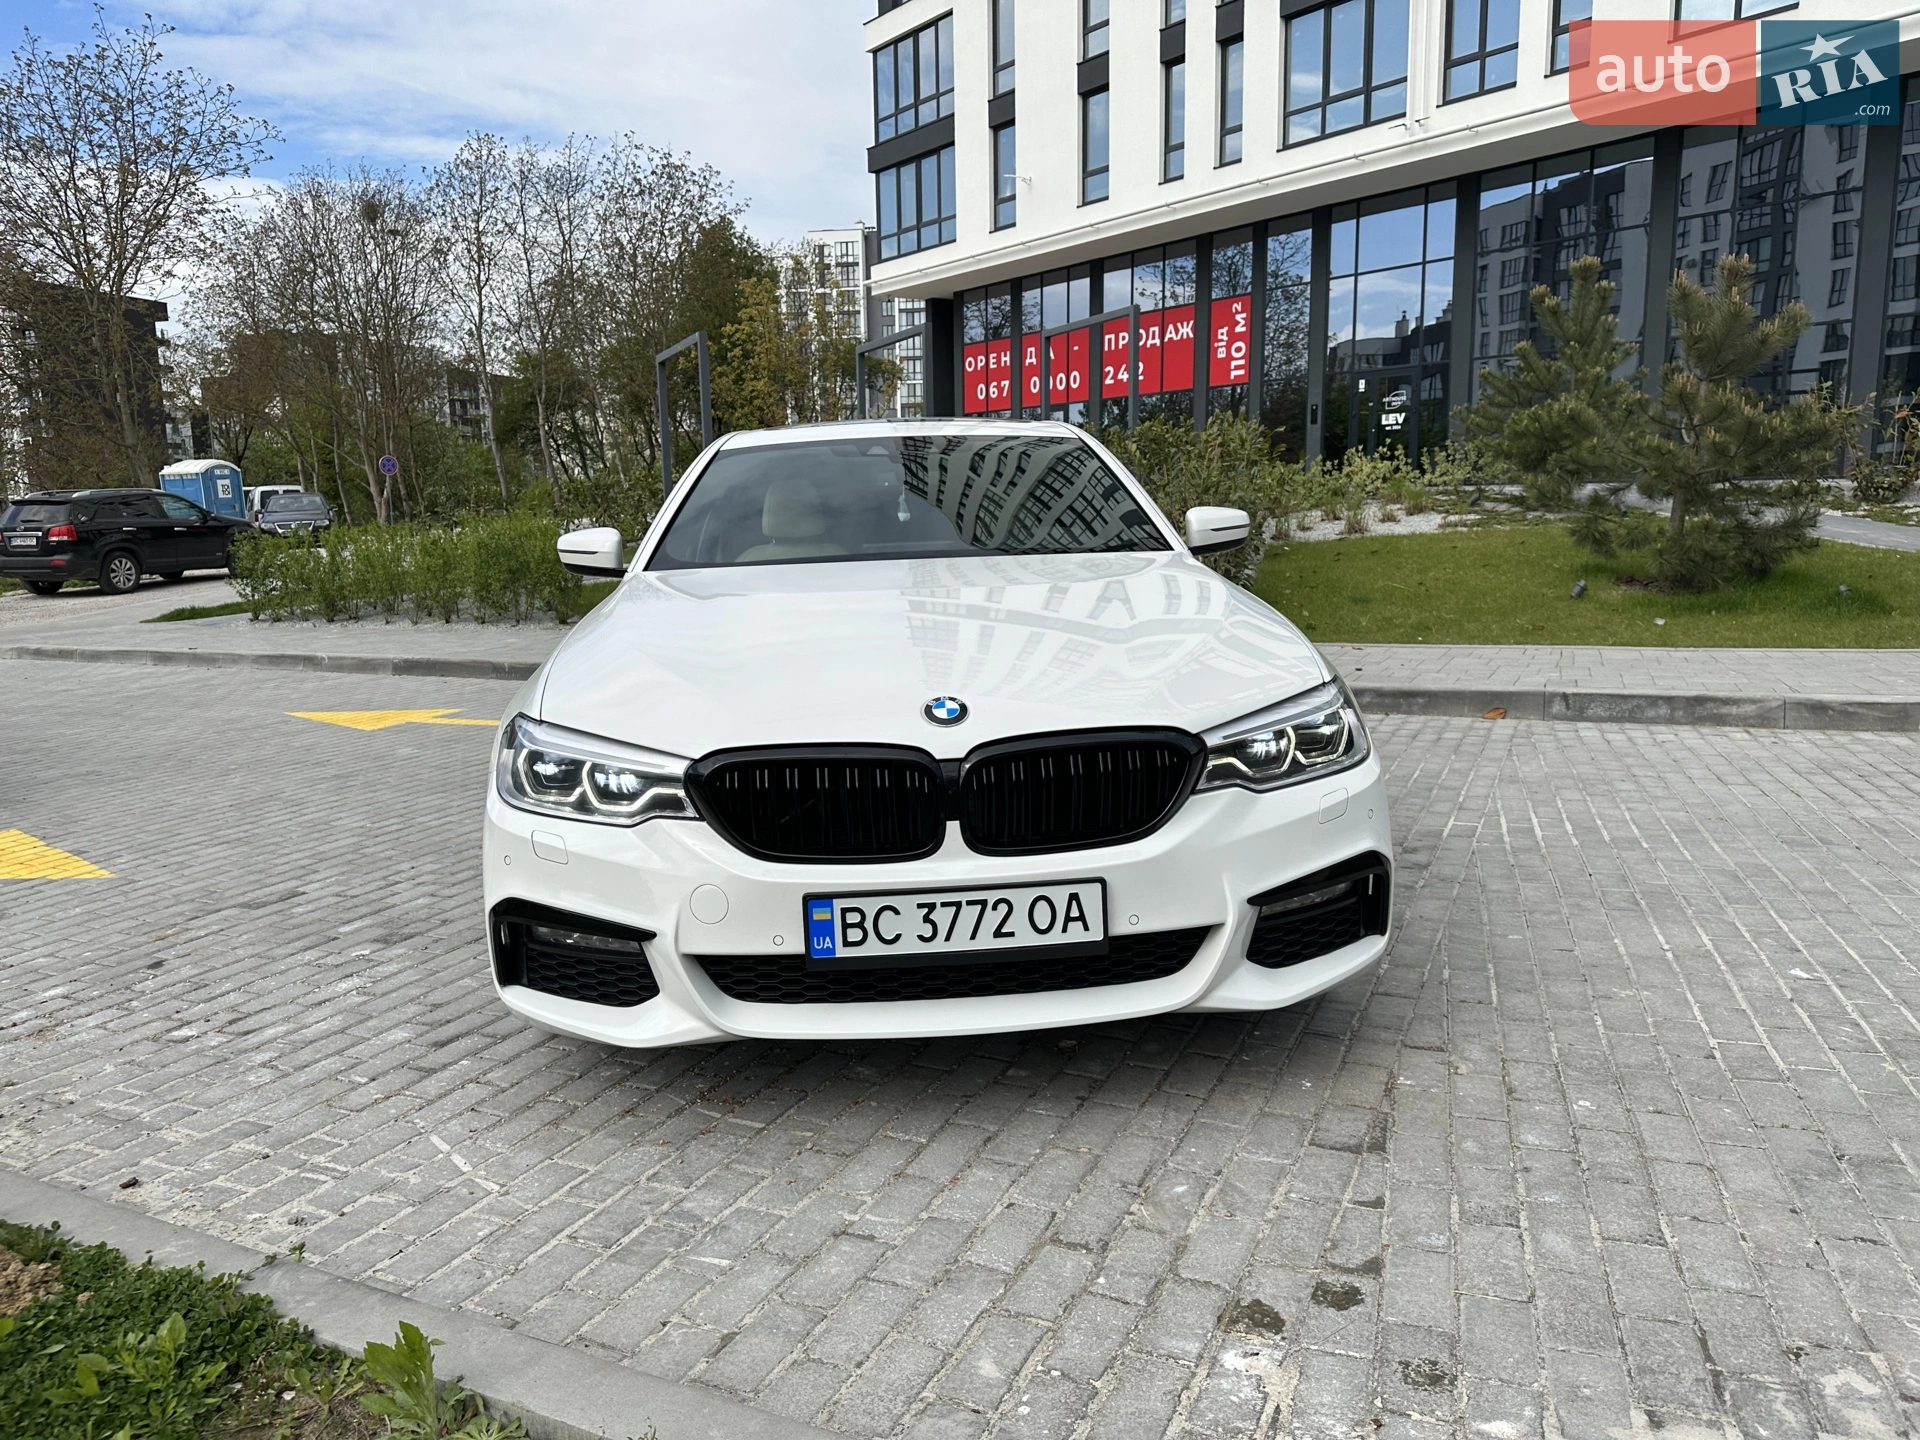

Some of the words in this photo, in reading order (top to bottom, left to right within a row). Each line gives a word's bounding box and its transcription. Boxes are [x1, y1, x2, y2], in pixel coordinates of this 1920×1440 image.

[1104, 320, 1194, 351] ПРОДАЖ
[1230, 341, 1246, 380] 110
[977, 380, 1010, 400] 067
[1104, 361, 1144, 385] 242
[1381, 413, 1406, 425] LEV
[840, 904, 902, 948] BC
[916, 897, 1016, 943] 3772
[1028, 892, 1090, 935] OA
[813, 937, 833, 949] UA
